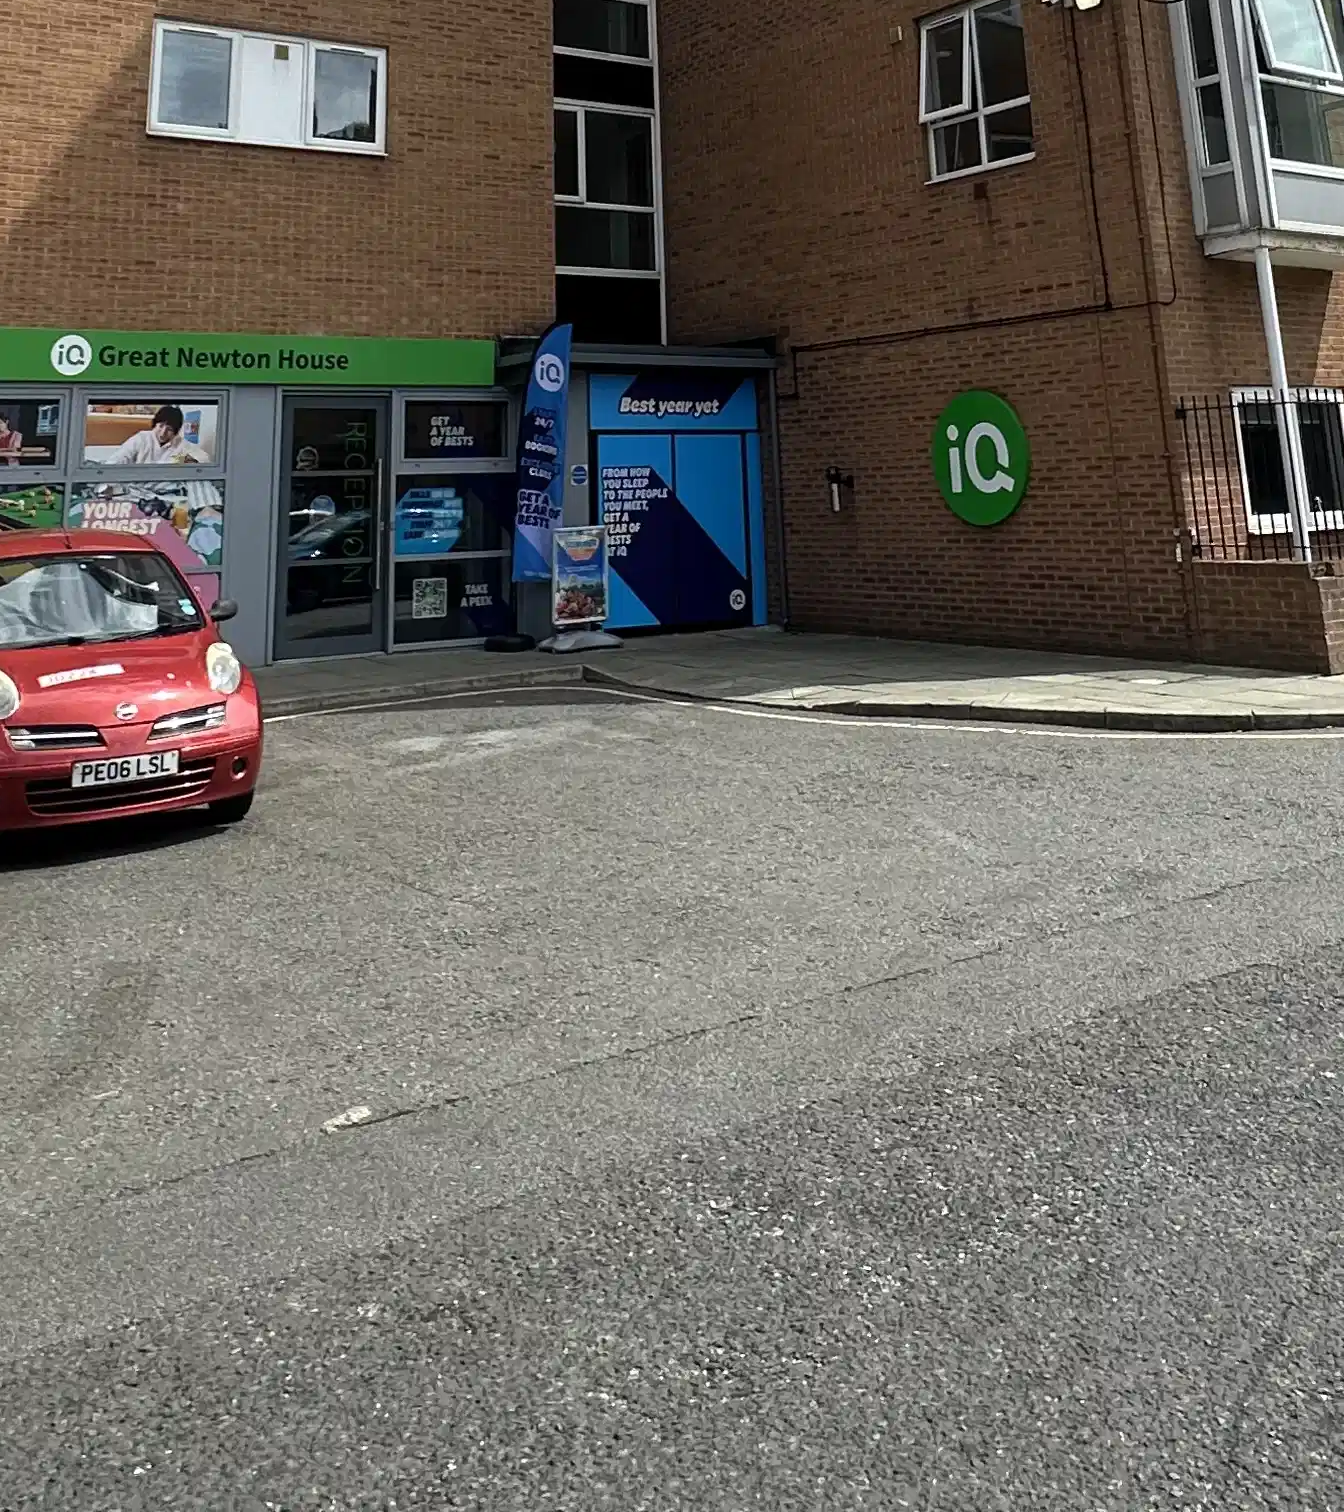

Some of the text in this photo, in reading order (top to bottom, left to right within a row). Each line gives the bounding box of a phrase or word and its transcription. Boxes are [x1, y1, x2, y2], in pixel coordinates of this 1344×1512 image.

[57, 344, 350, 371] iQ Great Newton House
[539, 360, 561, 385] iQ
[619, 396, 720, 417] Best year yet
[430, 416, 450, 427] GET
[429, 426, 465, 436] A YEAR
[430, 435, 474, 447] OF BESTS
[946, 421, 1016, 494] iQ
[602, 467, 628, 478] FROM
[603, 478, 622, 489] YOU
[604, 488, 668, 500] TO THE PEOPLE
[341, 421, 368, 584] RECEPION
[604, 500, 622, 511] YOU
[83, 501, 133, 520] YOUR
[603, 512, 630, 523] GET A
[628, 522, 641, 533] OF
[81, 754, 171, 783] PE06 LSL
